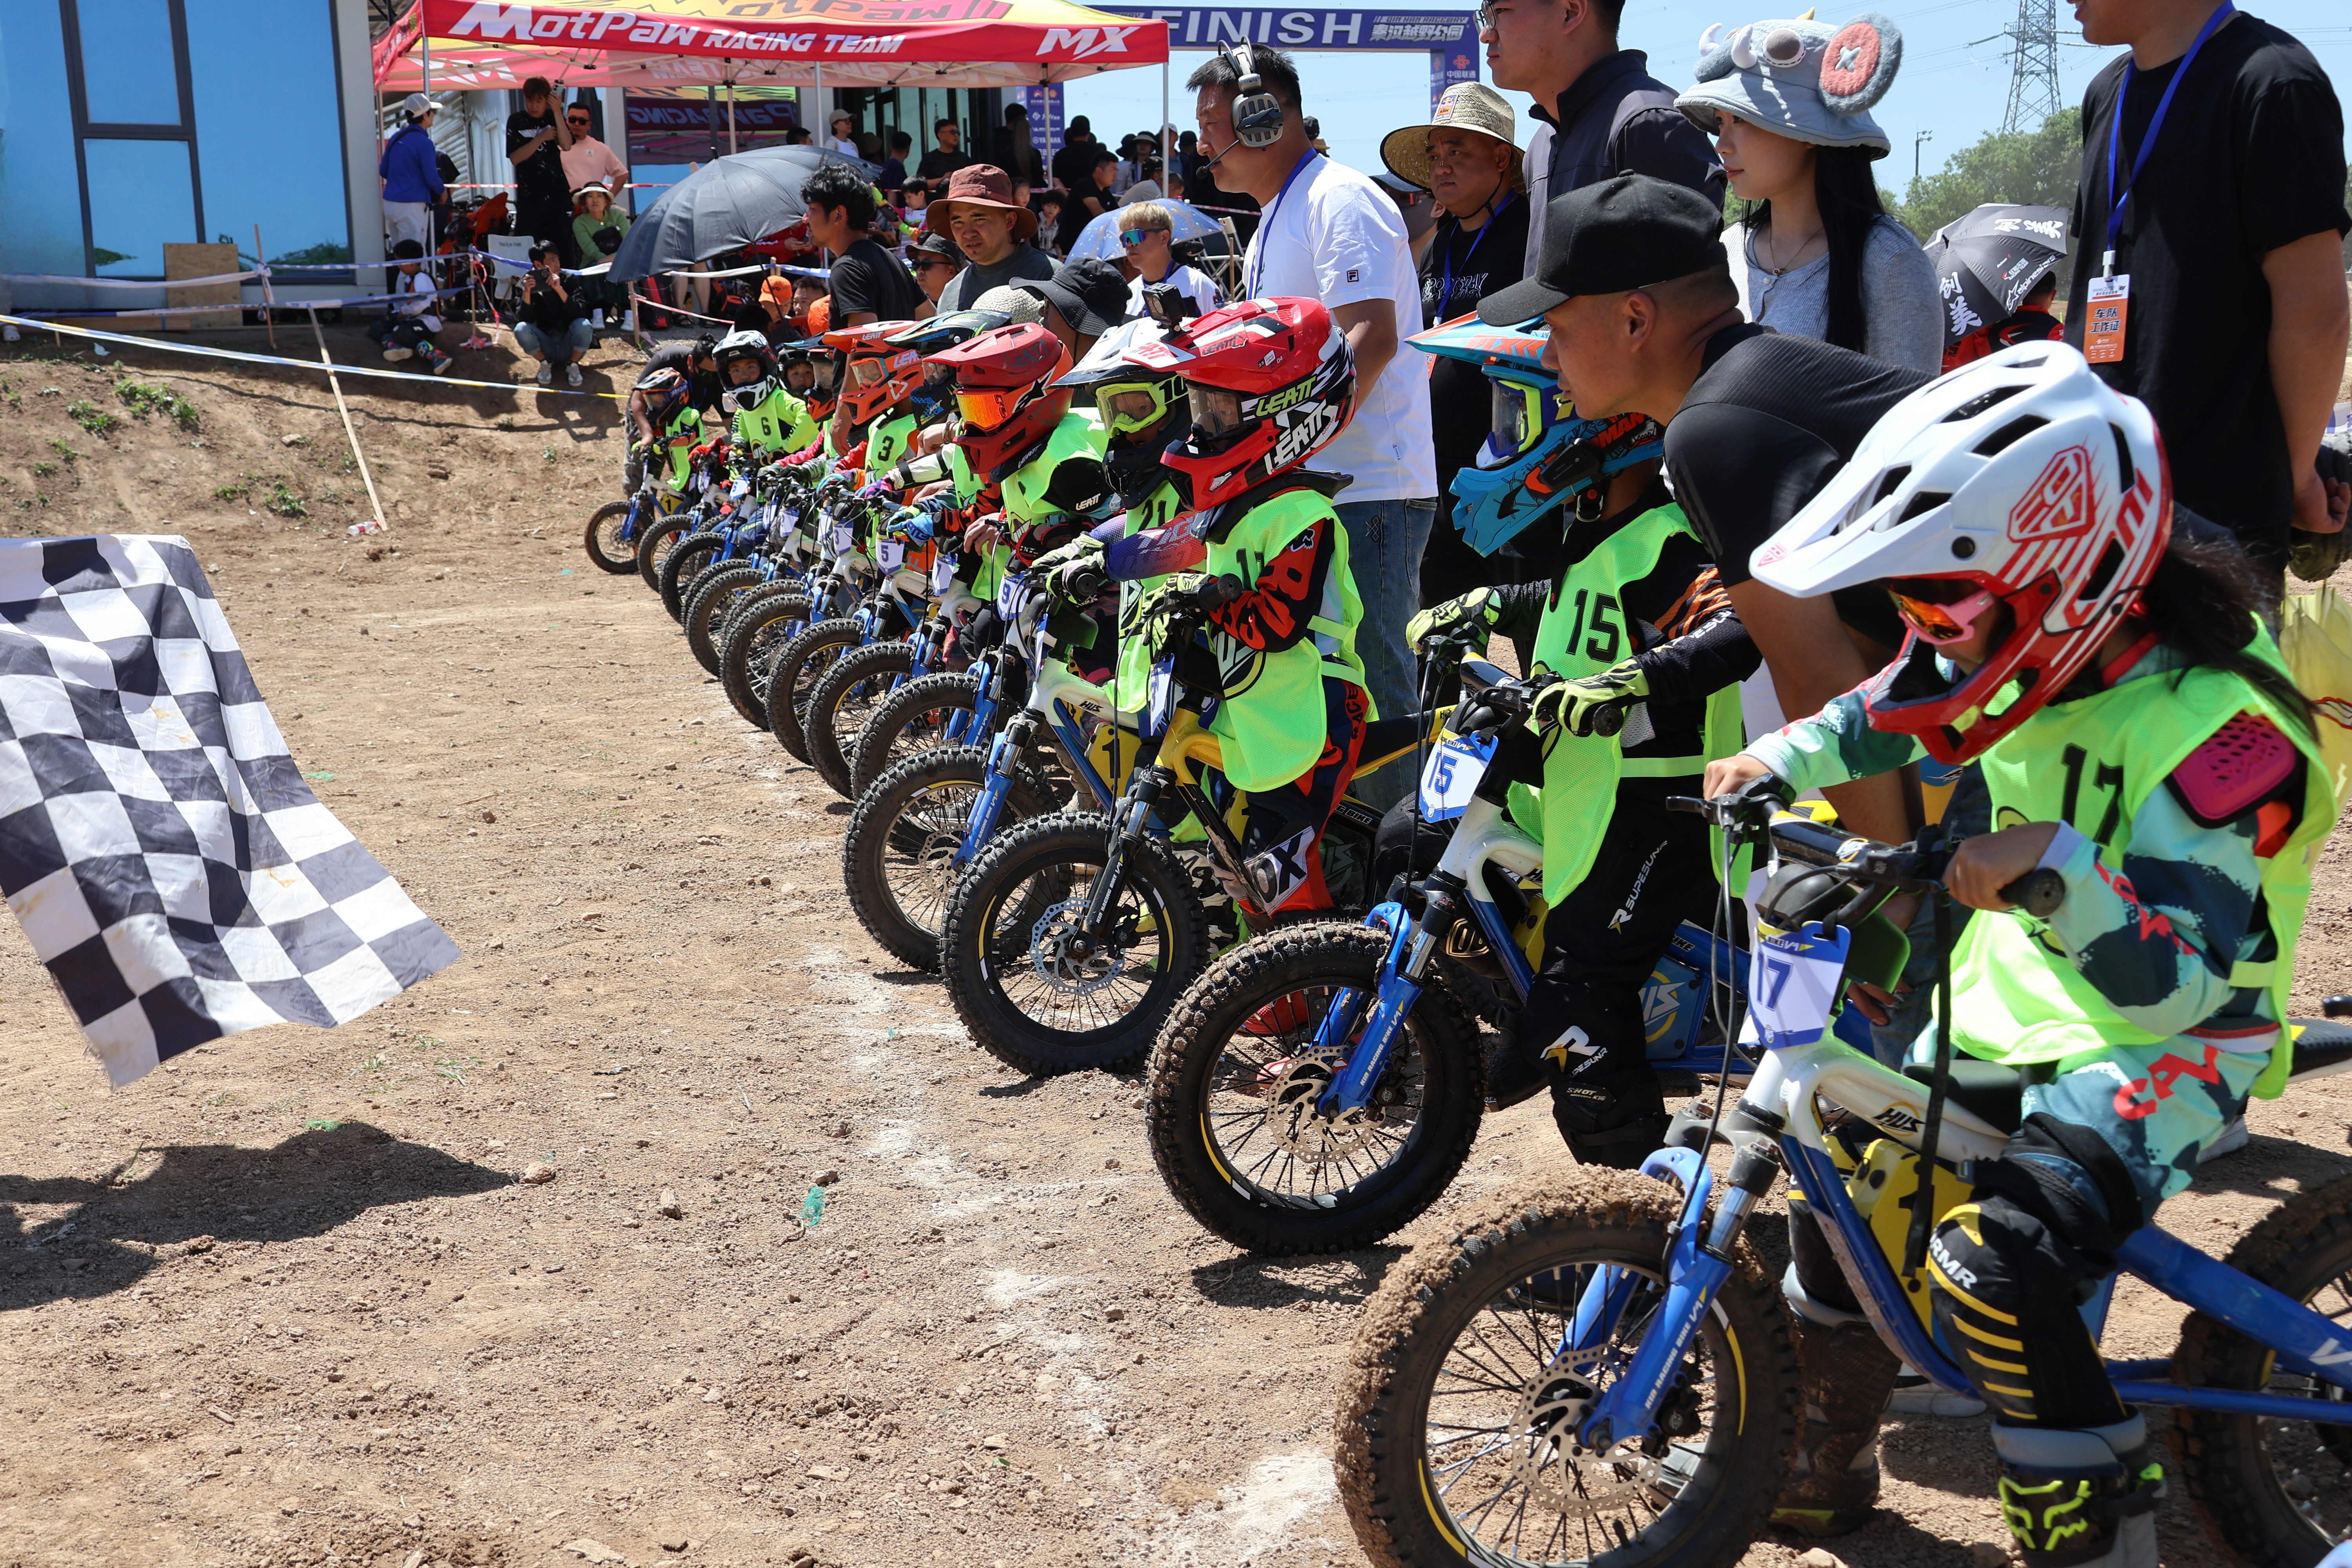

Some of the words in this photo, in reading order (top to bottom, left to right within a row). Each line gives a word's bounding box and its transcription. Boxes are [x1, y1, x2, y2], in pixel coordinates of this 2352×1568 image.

[703, 29, 817, 53] RACING
[824, 34, 907, 53] TEAM
[1152, 10, 1361, 45] FINISH
[1369, 24, 1465, 42] 秦汉越野公园
[1036, 27, 1140, 60] MX
[2017, 254, 2056, 294] alpinestars
[2094, 306, 2118, 319] 车队
[862, 331, 883, 341] LEATT
[2089, 319, 2122, 334] 工作证
[1255, 375, 1318, 417] LEATT
[761, 416, 771, 436] 6
[1263, 398, 1327, 475] LEATT
[877, 435, 895, 462] 3
[1076, 493, 1101, 511] LEATT
[1138, 499, 1167, 531] 21
[880, 544, 889, 563] 5
[1001, 581, 1011, 605] 9
[1566, 588, 1621, 664] 15
[1079, 700, 1104, 712] HUS
[1346, 686, 1364, 740] RACE
[1426, 750, 1460, 796] 15
[2061, 742, 2123, 847] 17
[979, 818, 988, 838] RACING
[1345, 809, 1373, 825] BIKE
[1251, 832, 1308, 904] OX
[1101, 887, 1112, 911] RACING
[1756, 949, 1794, 1012] 17
[1568, 1047, 1608, 1078] UPESUNR
[1871, 1107, 1927, 1132] HUS
[1655, 1347, 1677, 1387] RACING
[1676, 1320, 1691, 1348] BIKE
